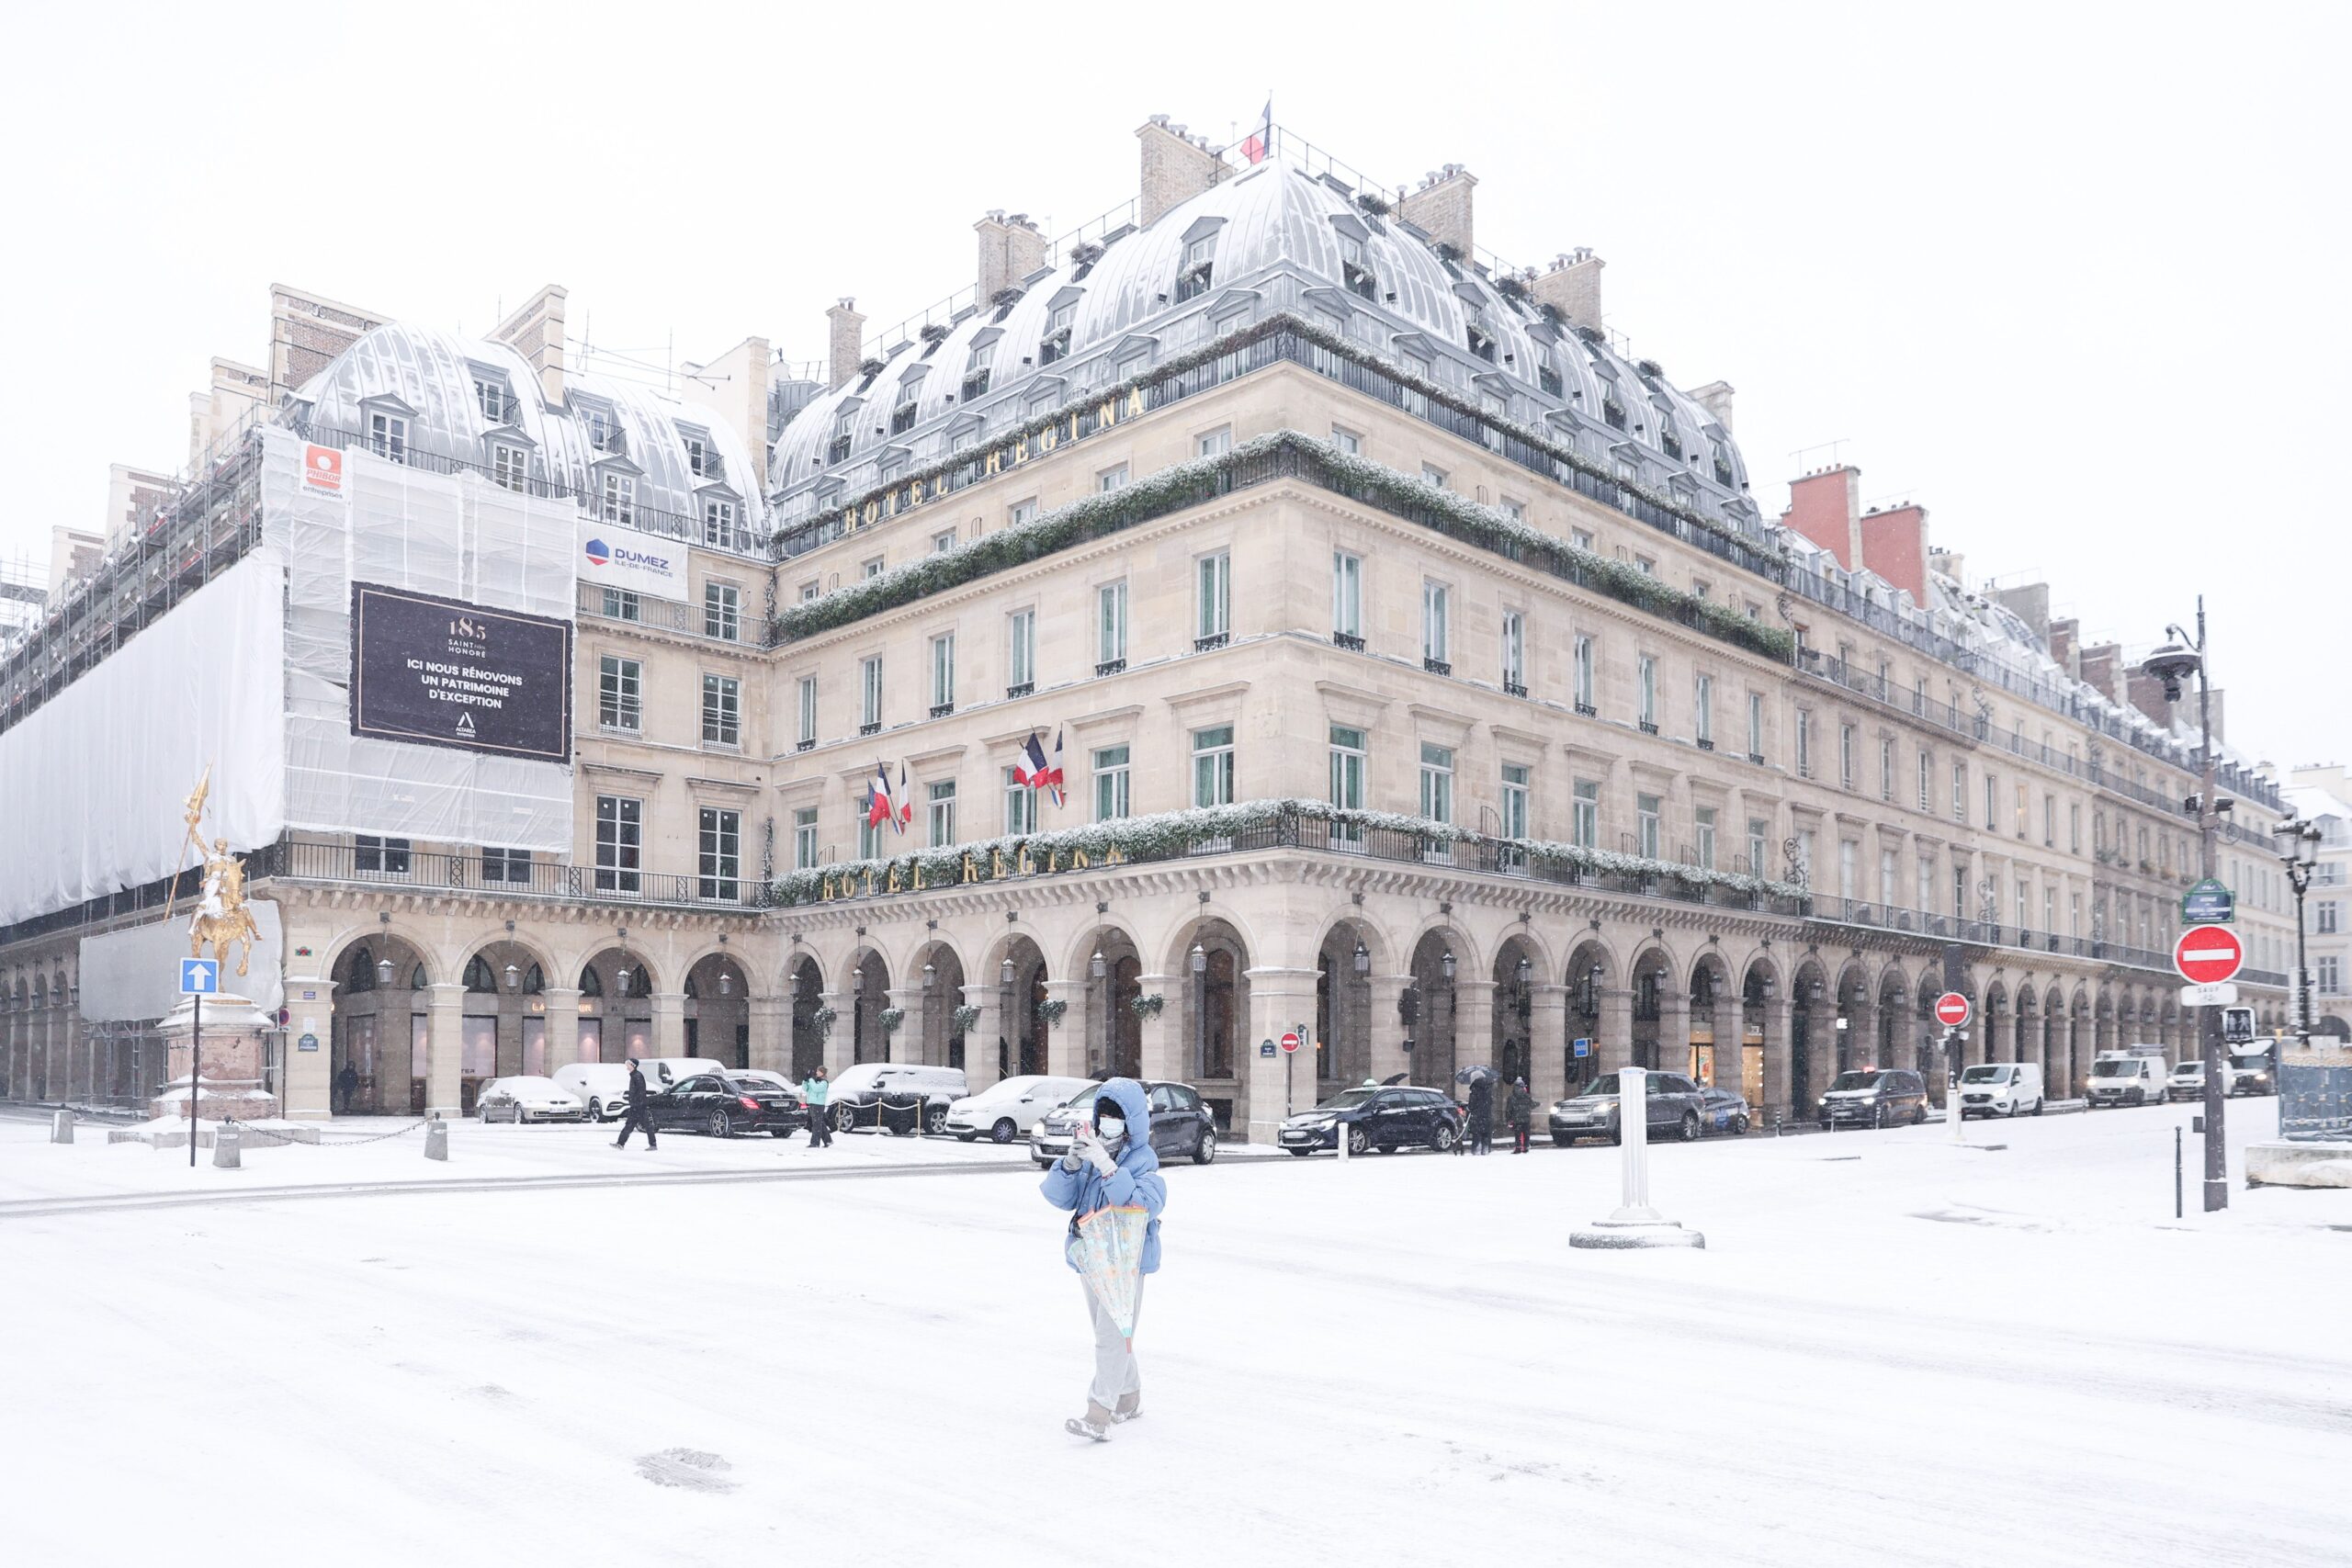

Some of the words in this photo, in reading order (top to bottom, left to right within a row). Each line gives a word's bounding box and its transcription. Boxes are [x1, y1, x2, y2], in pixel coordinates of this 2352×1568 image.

[845, 474, 948, 532] HOTEL
[985, 386, 1146, 475] REGINA
[307, 468, 341, 483] PHIBOR
[302, 486, 344, 499] entreprises
[614, 558, 673, 578] ÎLE-DE-FRANCE
[615, 548, 670, 570] DUMEZ
[449, 616, 486, 640] 185
[447, 638, 474, 649] SAINT
[447, 646, 486, 659] HONORÉ
[407, 659, 424, 671] ICI
[425, 661, 459, 676] NOUS
[461, 666, 523, 686] RÉNOVONS
[421, 674, 439, 686] UN
[441, 677, 510, 697] PATRIMOINE
[428, 688, 503, 709] D'EXCEPTION
[822, 863, 926, 900] HOTEL
[962, 843, 1125, 883] REGINA
